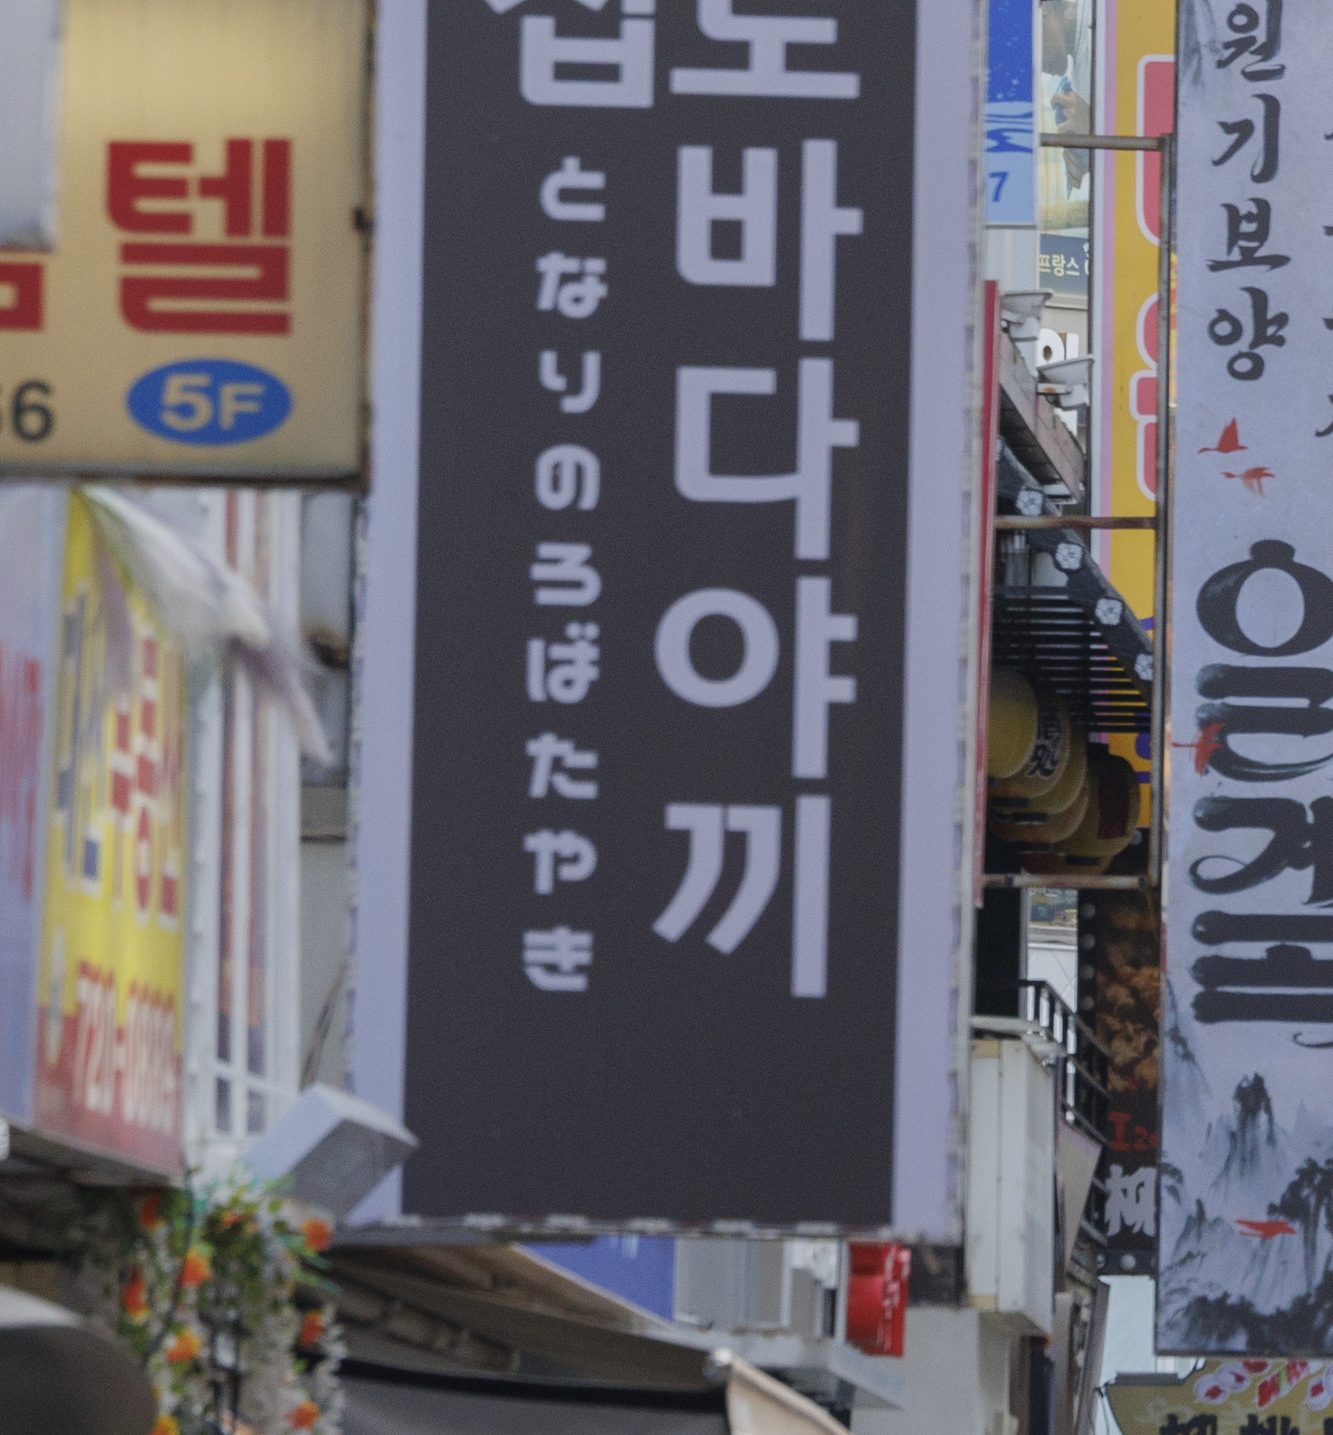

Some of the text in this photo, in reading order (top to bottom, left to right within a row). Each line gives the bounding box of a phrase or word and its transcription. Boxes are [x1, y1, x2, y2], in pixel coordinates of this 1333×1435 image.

[160, 372, 267, 432] 5F
[523, 157, 607, 992] となりのろばたやき
